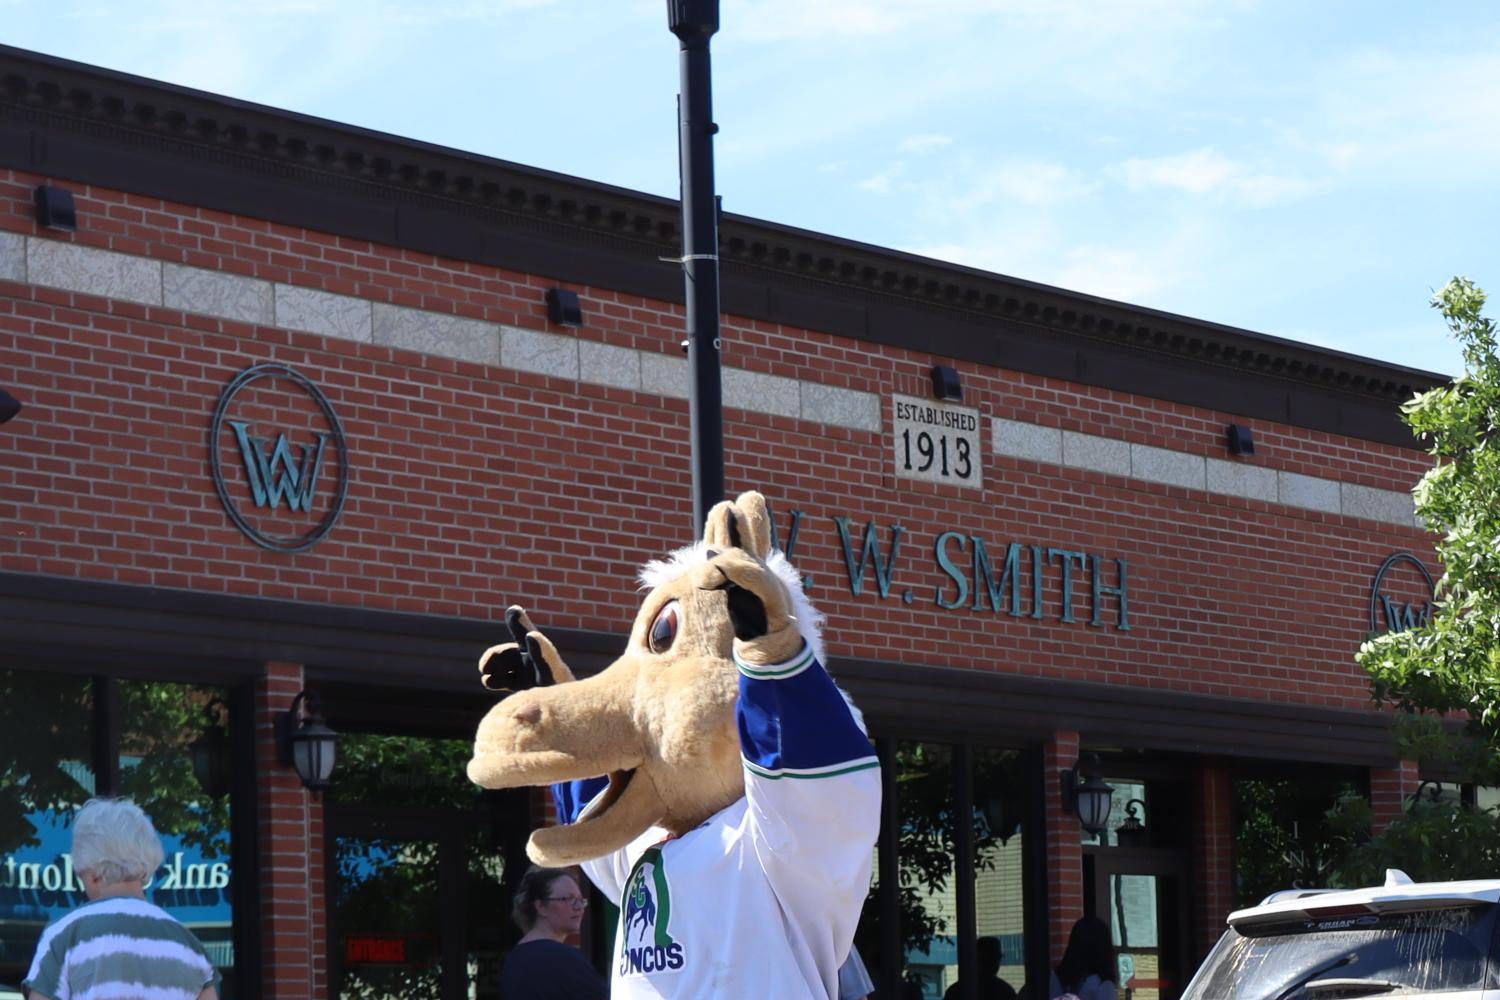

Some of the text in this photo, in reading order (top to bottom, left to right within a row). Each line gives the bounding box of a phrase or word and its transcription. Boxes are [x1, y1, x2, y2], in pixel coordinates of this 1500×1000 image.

[896, 402, 976, 432] ESTABLISHED
[902, 428, 972, 479] 1913
[833, 516, 914, 604] W.
[935, 531, 1133, 631] SMITH
